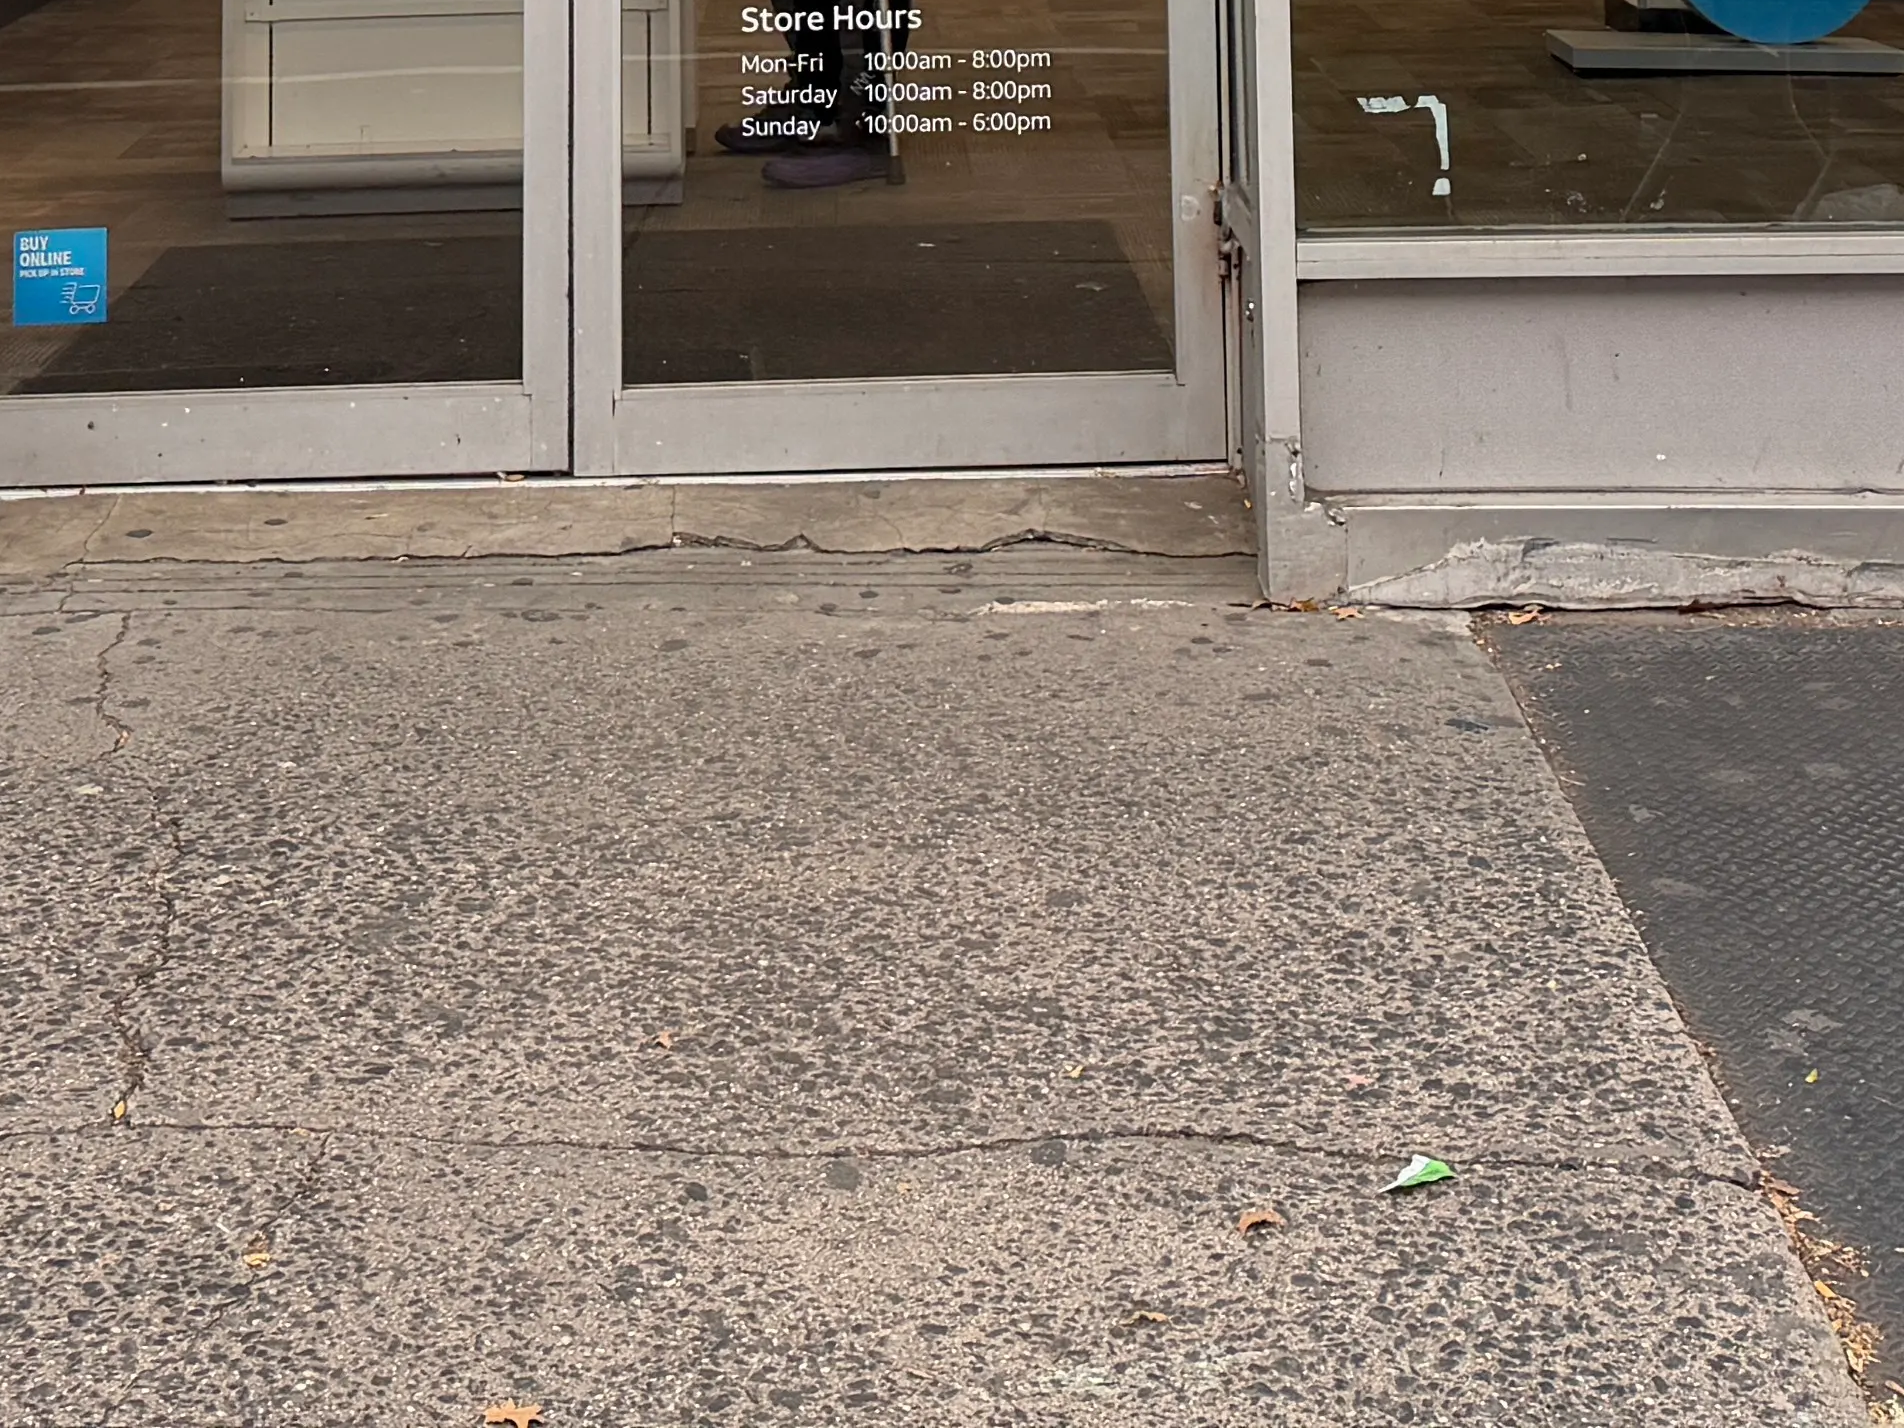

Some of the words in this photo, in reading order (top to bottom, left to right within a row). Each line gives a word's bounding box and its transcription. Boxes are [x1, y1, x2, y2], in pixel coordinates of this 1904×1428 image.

[741, 7, 824, 33] Store
[833, 5, 922, 31] Hours
[741, 52, 824, 74] Mon-Fri
[864, 52, 952, 71] 10:00am
[972, 50, 1051, 74] 8:00pm
[741, 85, 838, 108] Saturday
[864, 83, 952, 102] 10:00am
[972, 81, 1051, 105] 8:00pm
[741, 117, 821, 140] Sunday
[864, 115, 952, 134] 10:00am
[972, 112, 1051, 136] 6:00pm
[20, 236, 48, 251] BUY
[19, 251, 72, 267] ONLINE
[20, 270, 37, 278] PICK
[38, 269, 49, 277] UP
